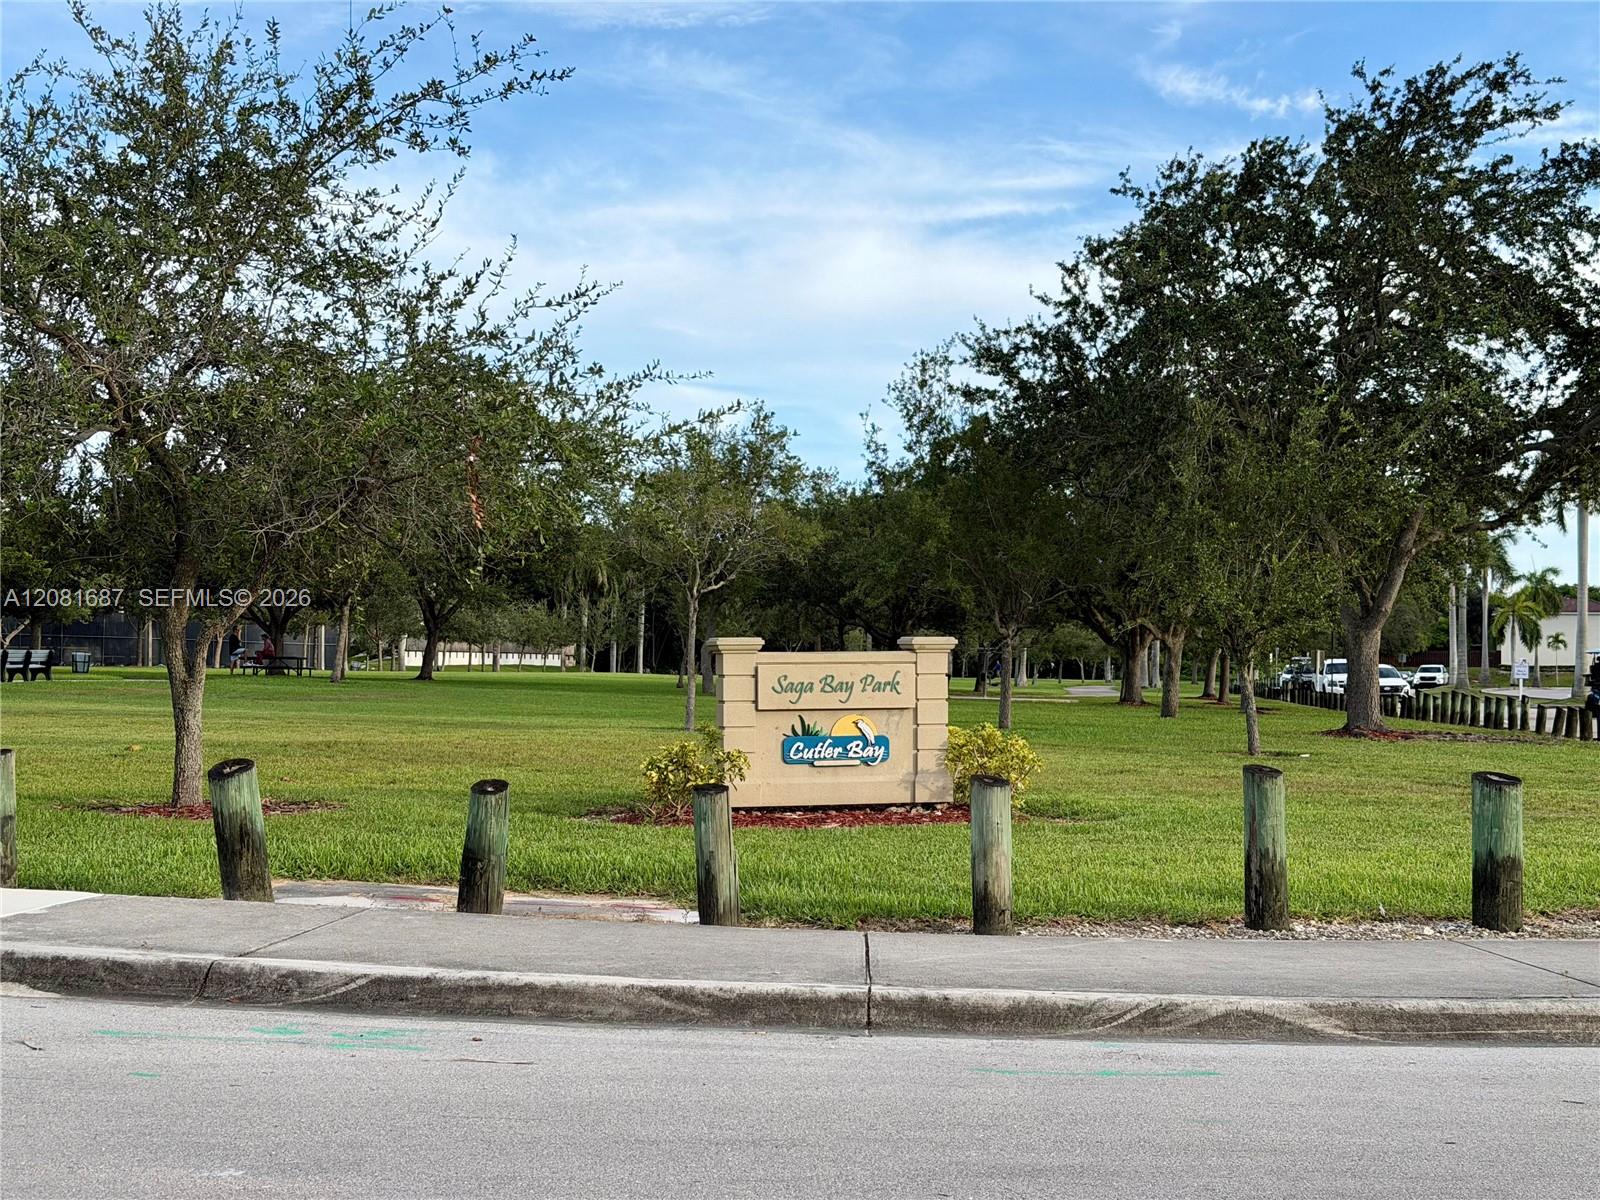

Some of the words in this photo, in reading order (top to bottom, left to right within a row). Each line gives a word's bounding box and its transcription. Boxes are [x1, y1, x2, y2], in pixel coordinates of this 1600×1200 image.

[771, 674, 814, 705] Saga
[819, 674, 855, 704] Bay
[860, 670, 902, 695] Park
[789, 739, 843, 760] Cutler
[846, 740, 885, 766] Bay
